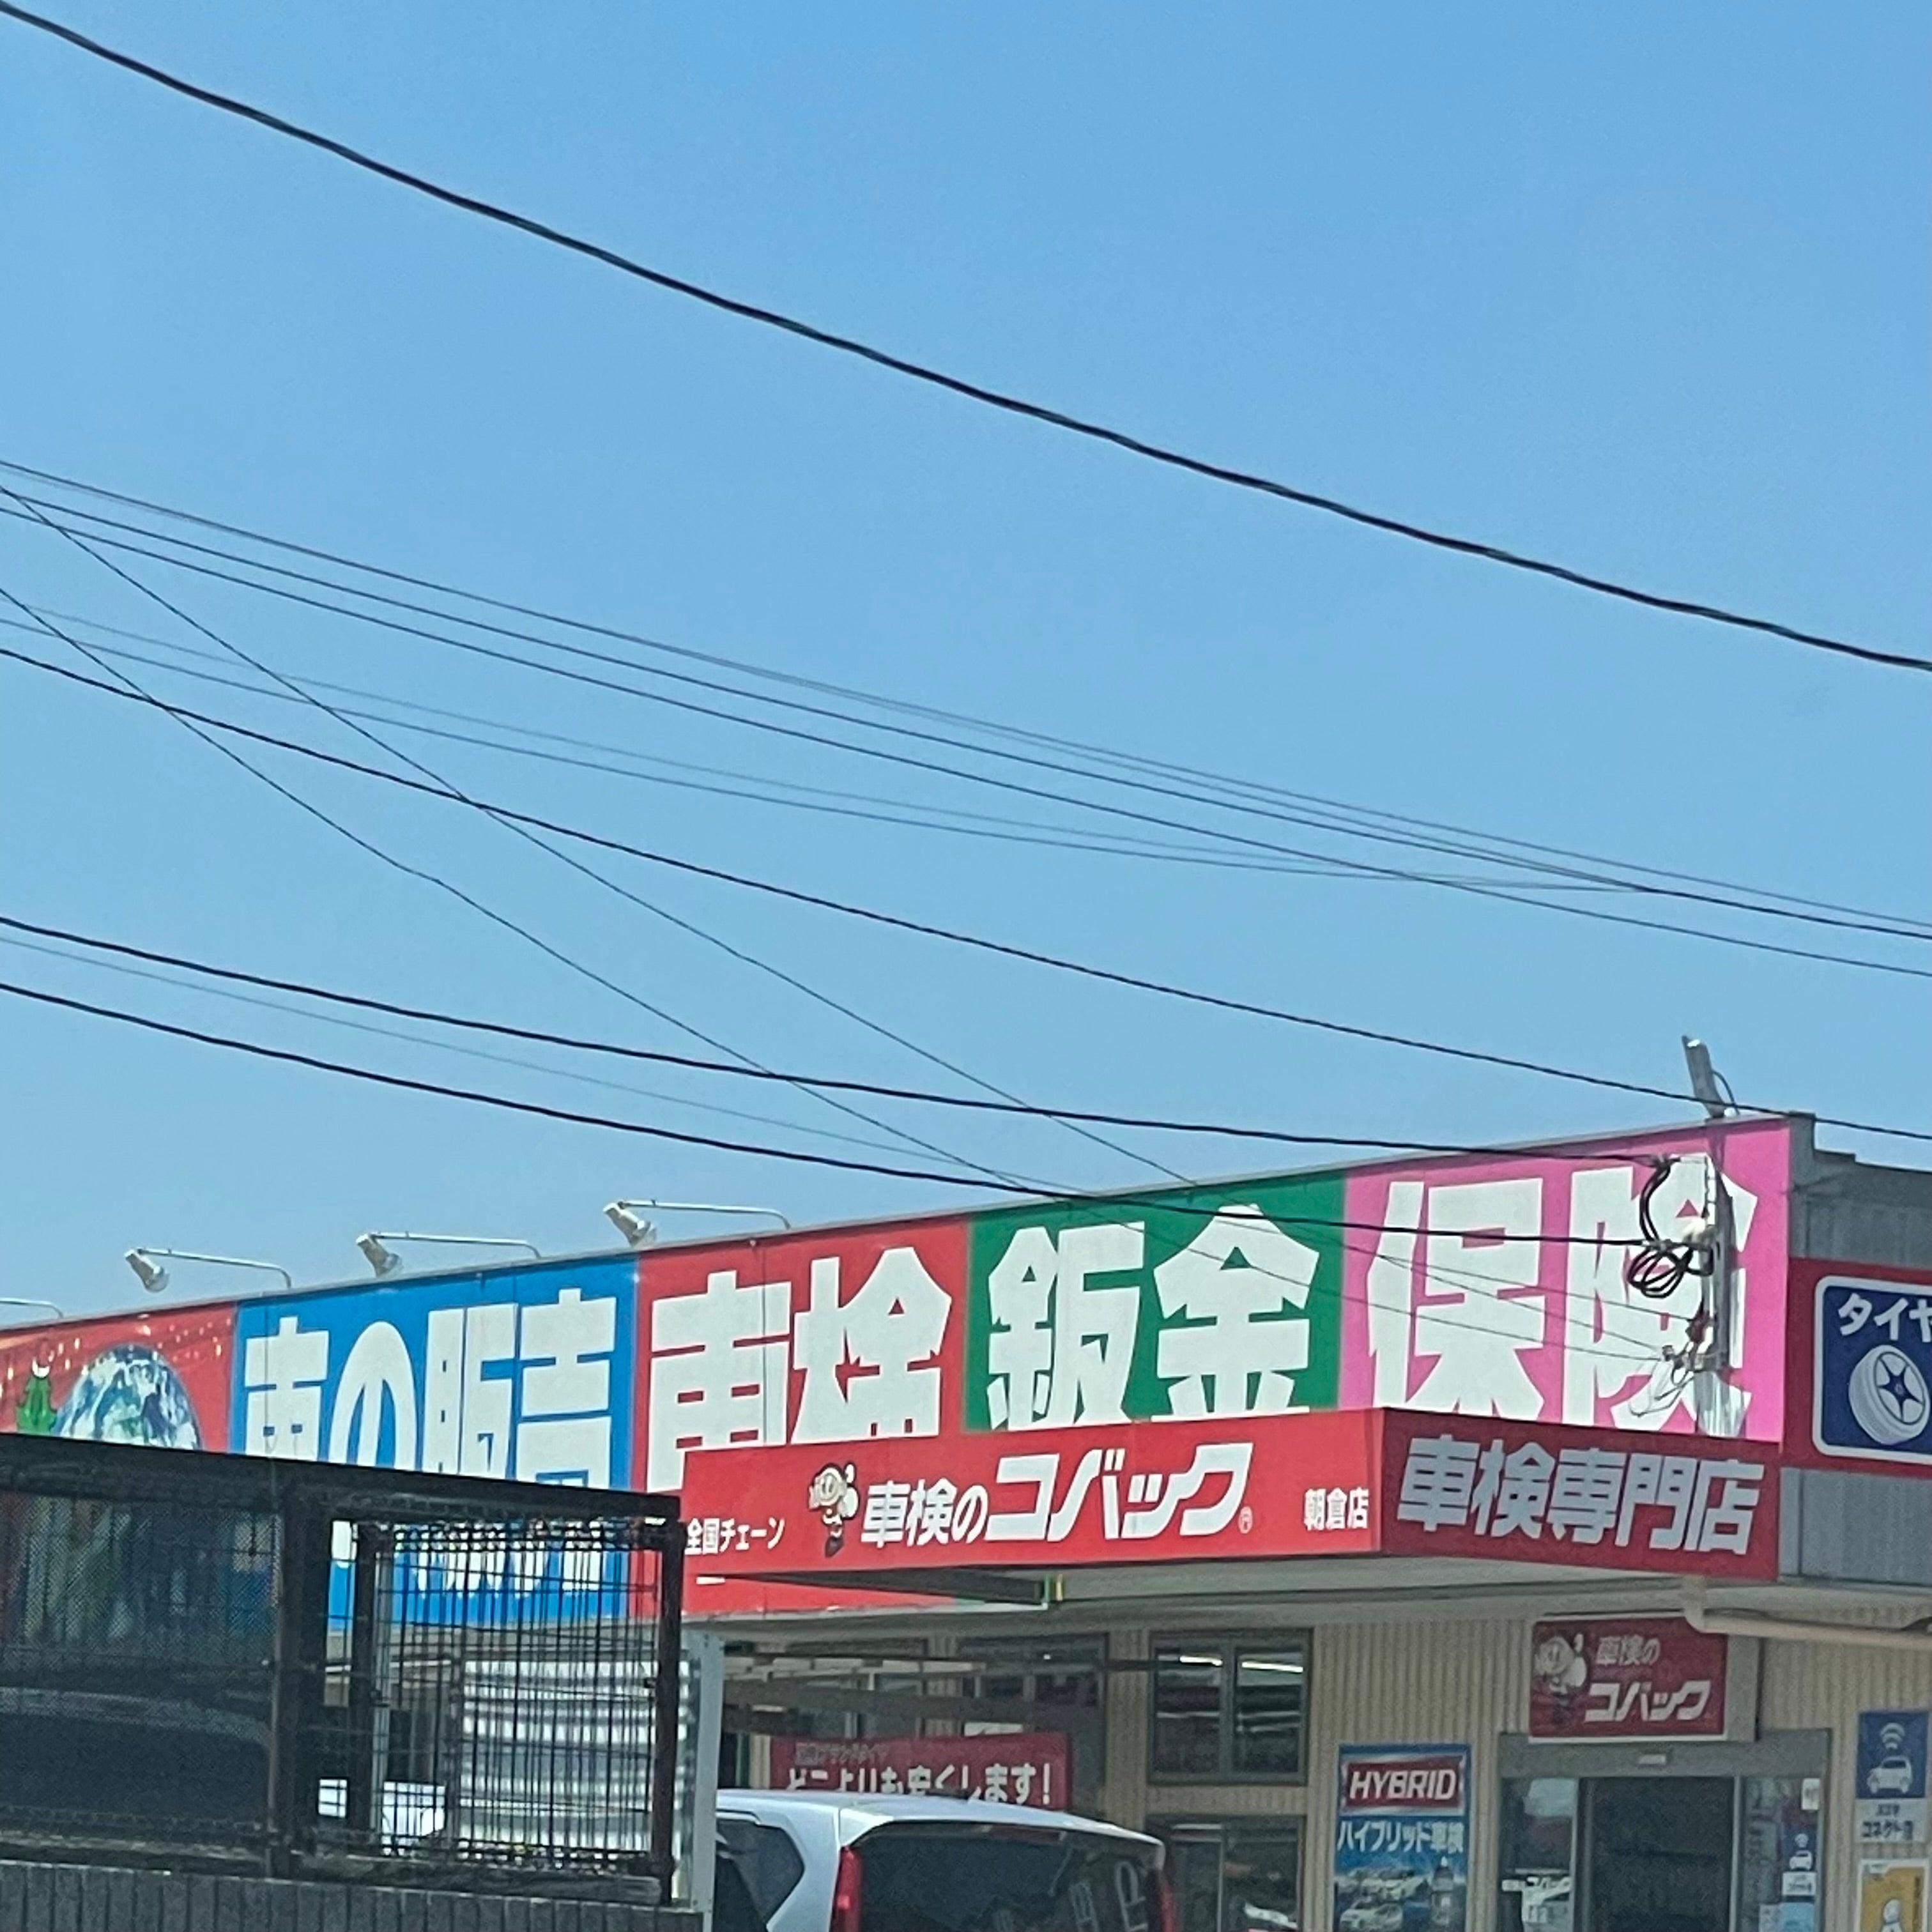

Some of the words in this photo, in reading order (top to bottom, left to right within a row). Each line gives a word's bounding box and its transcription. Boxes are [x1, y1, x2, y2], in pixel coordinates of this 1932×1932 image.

[986, 1204, 1319, 1431] 鈑金
[1368, 1153, 1758, 1438] 保険
[1838, 1292, 1932, 1342] タイヤ
[647, 1246, 952, 1492] 車検
[1304, 1487, 1369, 1531] 朝倉店
[1397, 1434, 1765, 1554] 車検専門店
[684, 1517, 786, 1555] 全国チェーン
[1584, 1680, 1711, 1722] コバック
[1349, 1768, 1457, 1801] HYBRID
